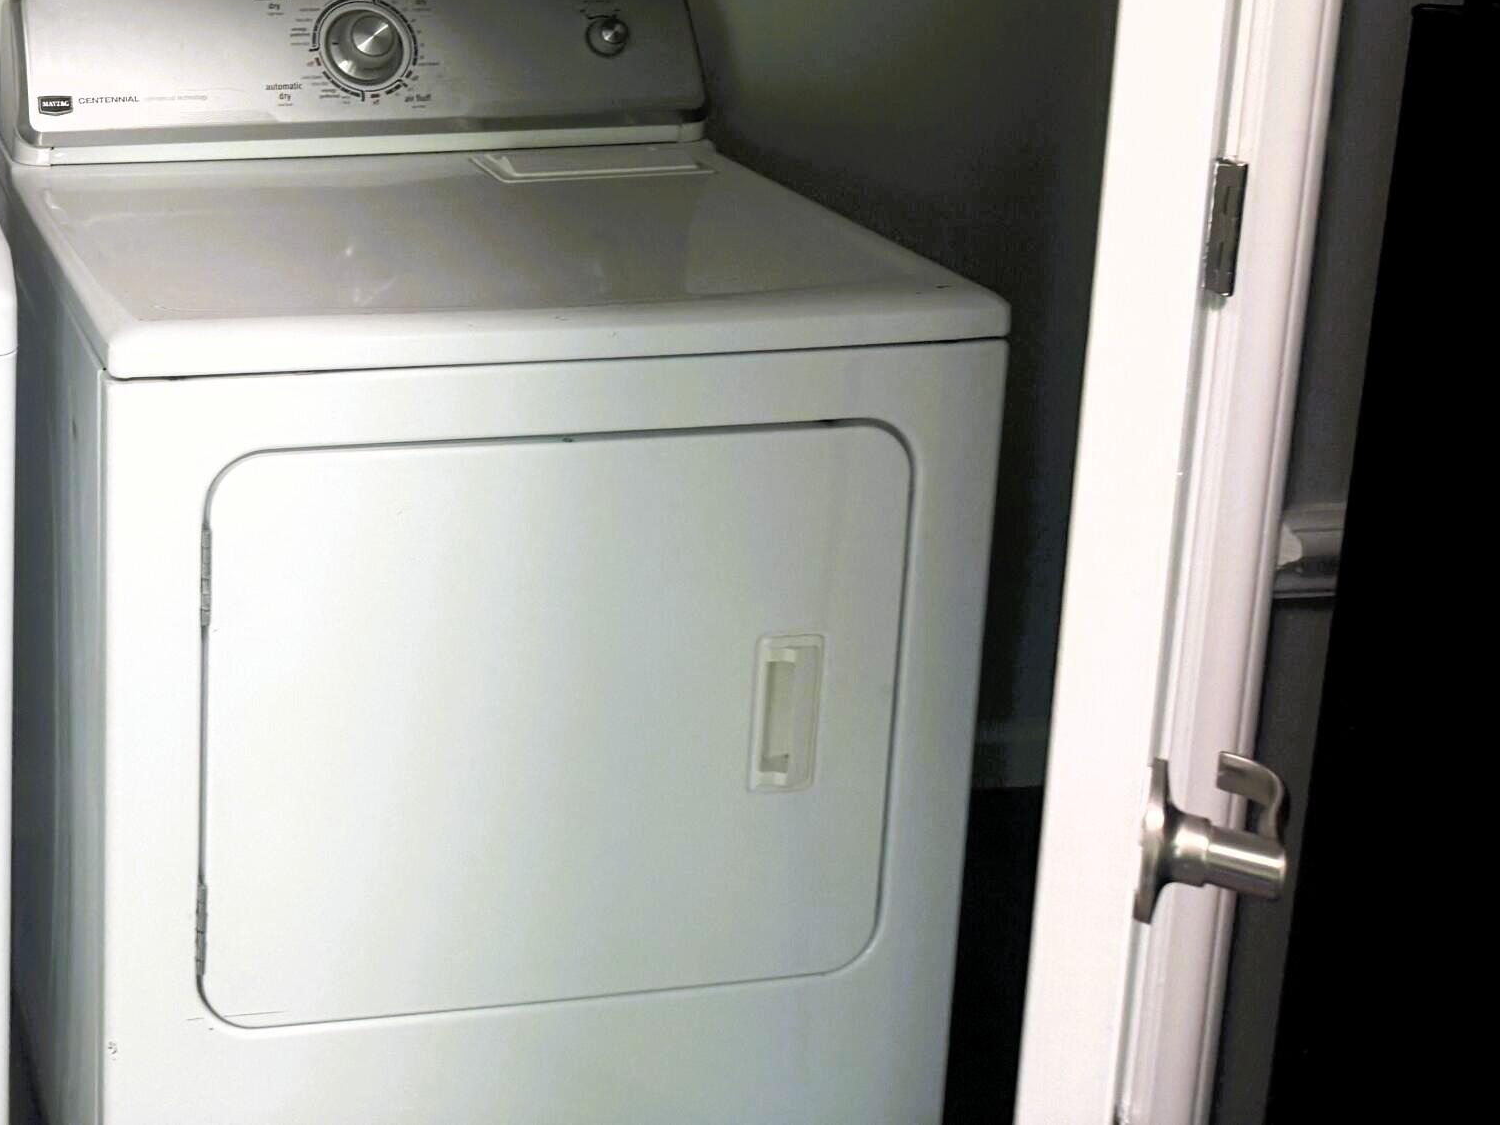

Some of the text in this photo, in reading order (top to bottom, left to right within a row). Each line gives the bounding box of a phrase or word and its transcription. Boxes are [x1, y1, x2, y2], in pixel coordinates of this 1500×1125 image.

[268, 2, 281, 10] dry
[265, 82, 302, 90] automatic
[78, 95, 140, 104] CENTENNIAL
[279, 93, 291, 101] dry
